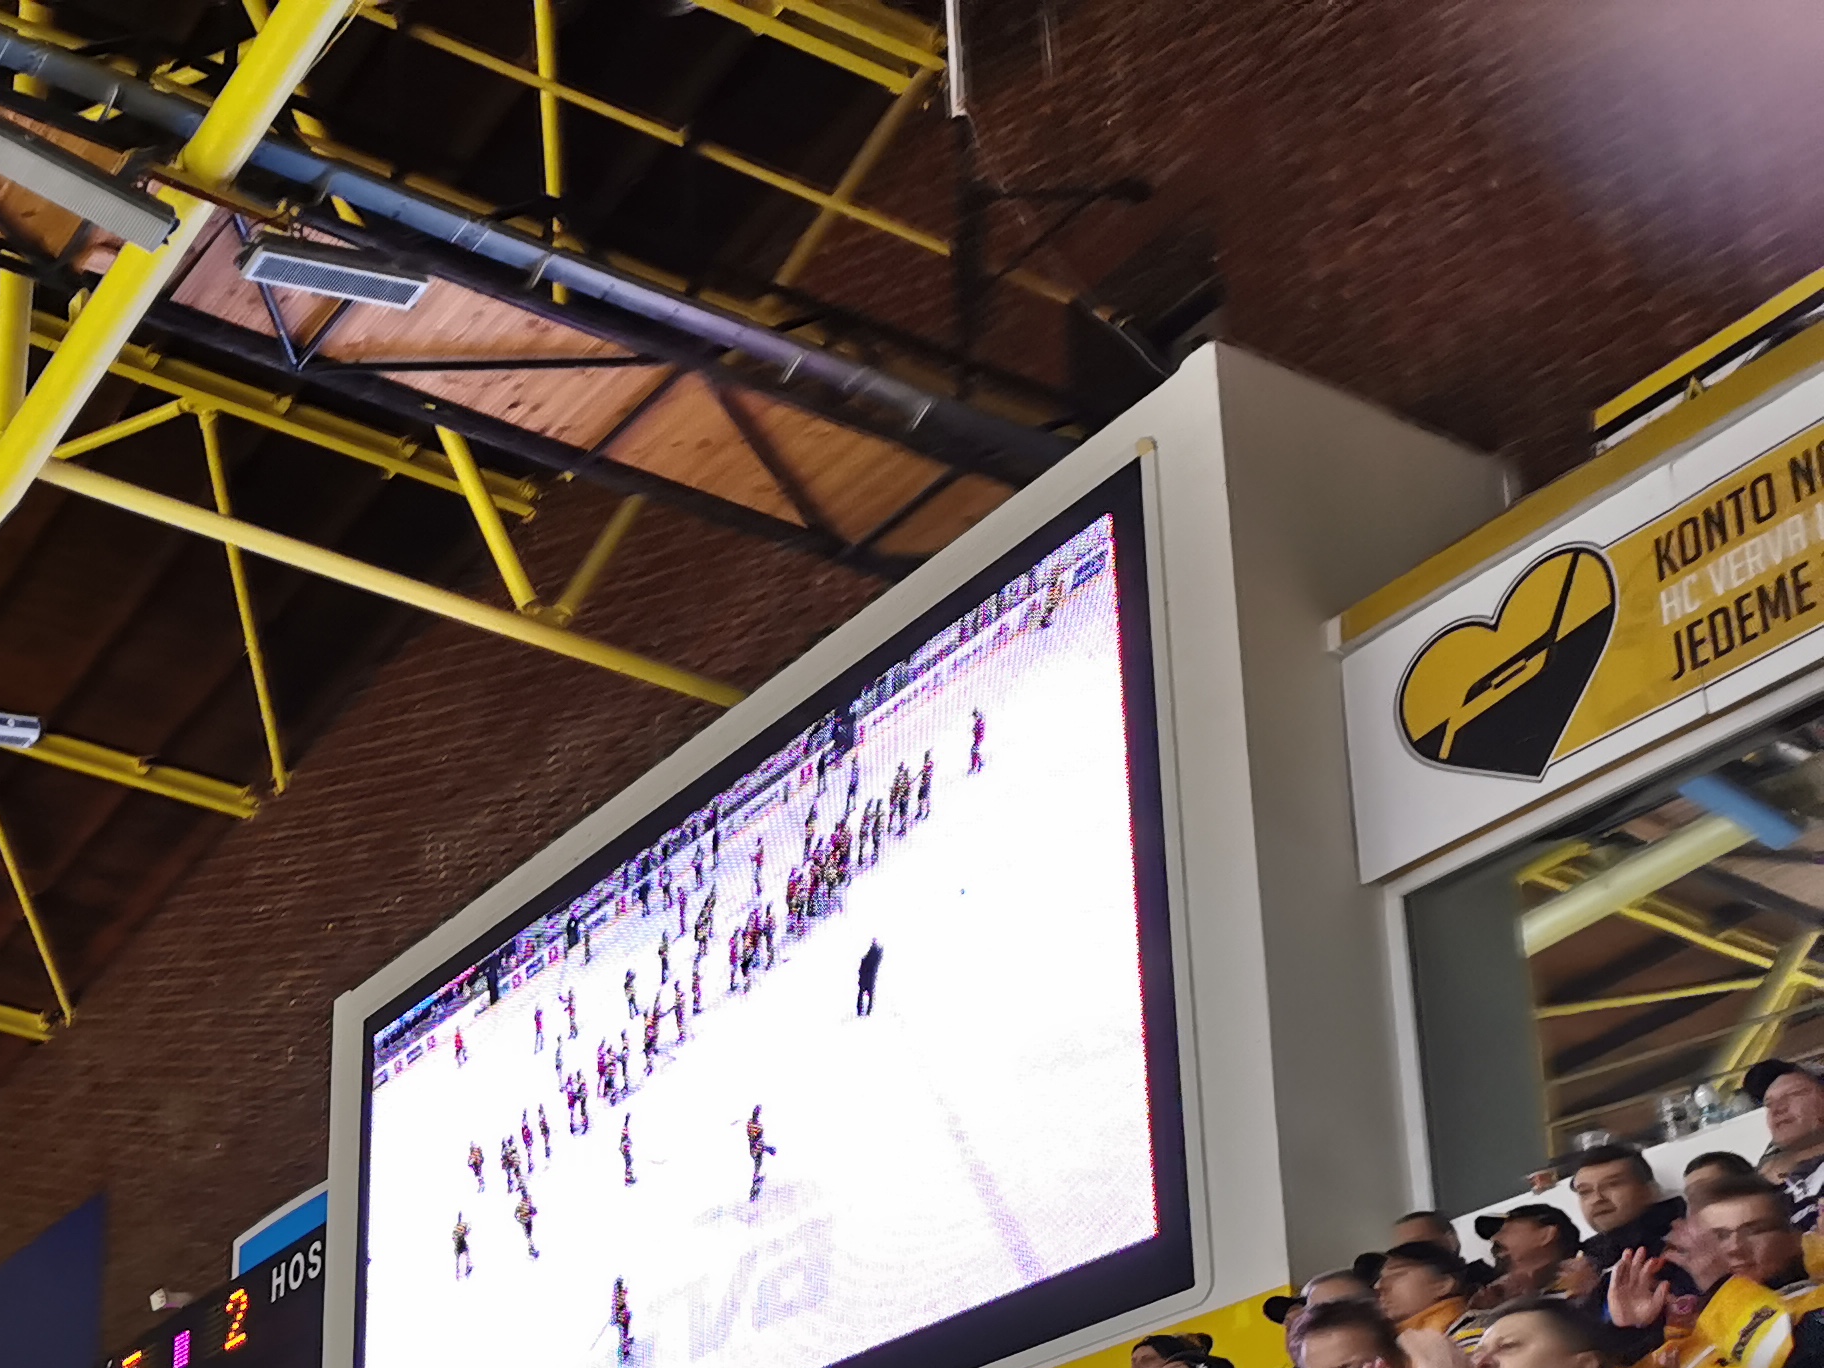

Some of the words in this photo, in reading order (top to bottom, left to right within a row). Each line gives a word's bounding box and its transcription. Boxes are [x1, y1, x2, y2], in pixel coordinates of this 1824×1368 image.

[1654, 473, 1777, 583] KONTO
[1660, 575, 1702, 626] HC
[1671, 560, 1817, 681] JEDEME
[270, 1240, 323, 1303] HOS
[225, 1287, 249, 1350] 2
